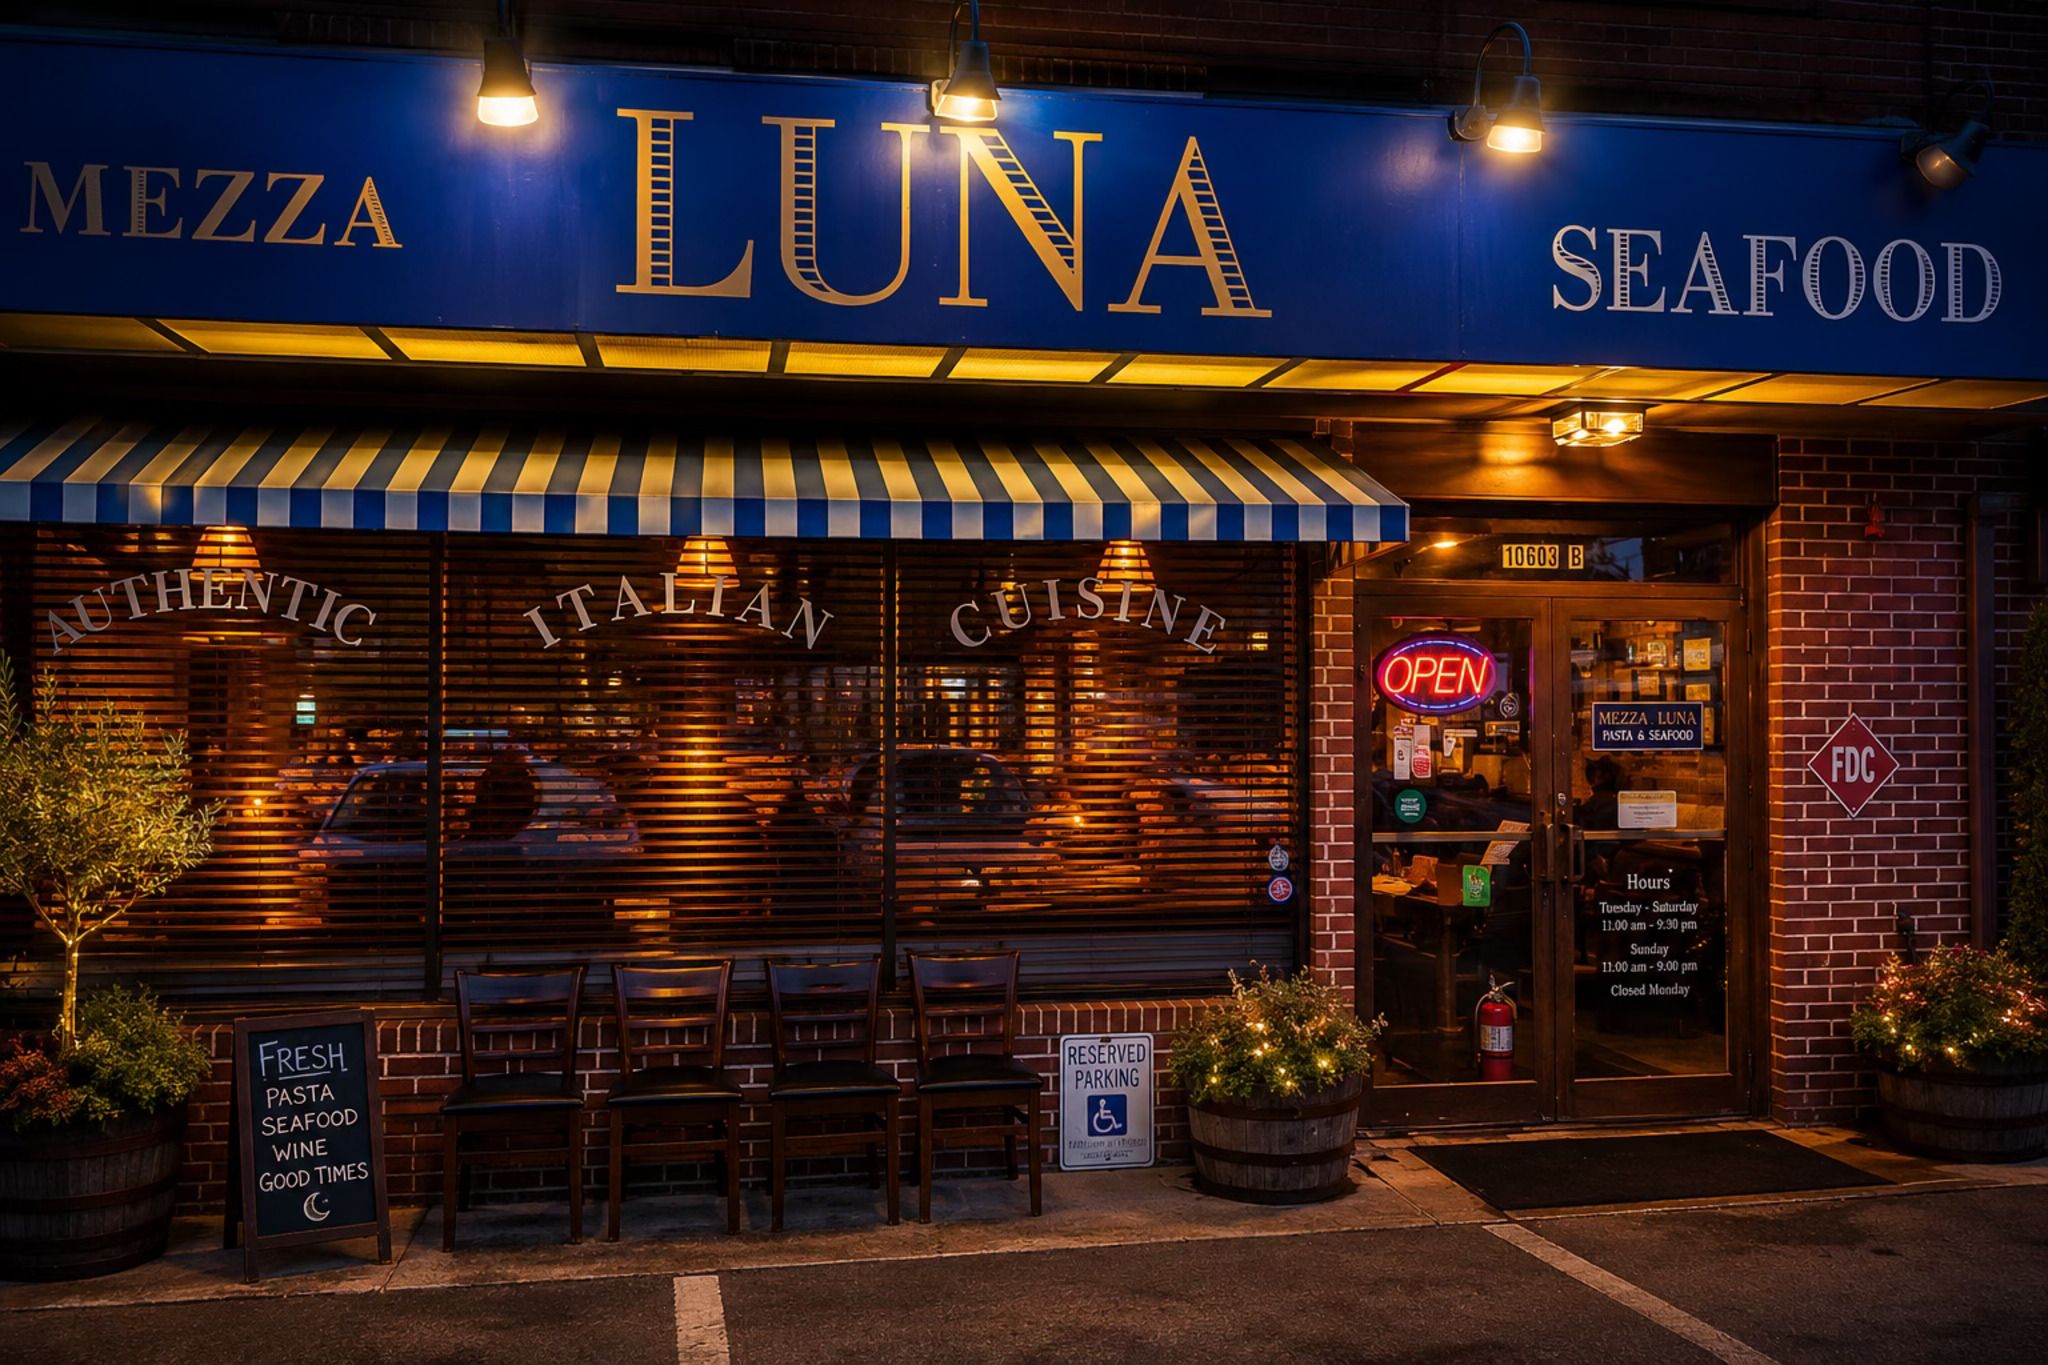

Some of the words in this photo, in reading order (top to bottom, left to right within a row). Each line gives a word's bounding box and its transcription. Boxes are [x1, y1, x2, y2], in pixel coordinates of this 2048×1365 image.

[20, 161, 402, 249] MEZZA
[615, 107, 1272, 318] LUNA
[1552, 224, 2002, 323] SEAFOOD
[1505, 545, 1557, 567] 10603
[1571, 545, 1582, 567] B
[47, 567, 376, 656] AUTHENTIC
[523, 572, 834, 650] ITALIAN
[950, 576, 1226, 655] CUISINE
[1384, 656, 1489, 695] OPEN
[1599, 711, 1648, 726] MEZZA
[1658, 711, 1697, 726] LUNA
[1602, 729, 1633, 741] PASTA
[1637, 731, 1645, 741] &
[1648, 729, 1694, 741] SEAFOOD
[1831, 745, 1875, 784] FDC
[1627, 873, 1671, 890] Hours
[1598, 901, 1642, 917] Tuesday
[1652, 900, 1699, 915] Saturday
[1630, 921, 1646, 931] am
[1681, 920, 1697, 933] pm
[1630, 942, 1669, 958] Sunday
[1630, 963, 1647, 973] am
[1681, 961, 1698, 975] pm
[1610, 983, 1646, 997] Closed
[1648, 982, 1690, 997] Monday
[258, 1040, 348, 1077] FRESH
[1067, 1043, 1146, 1066] RESERVED
[1075, 1068, 1140, 1089] PARKING
[266, 1084, 335, 1109] PASTA
[261, 1108, 358, 1136] SEAFOOD
[272, 1138, 328, 1162] WINE
[259, 1170, 311, 1192] GOOD
[314, 1161, 369, 1185] TIMES
